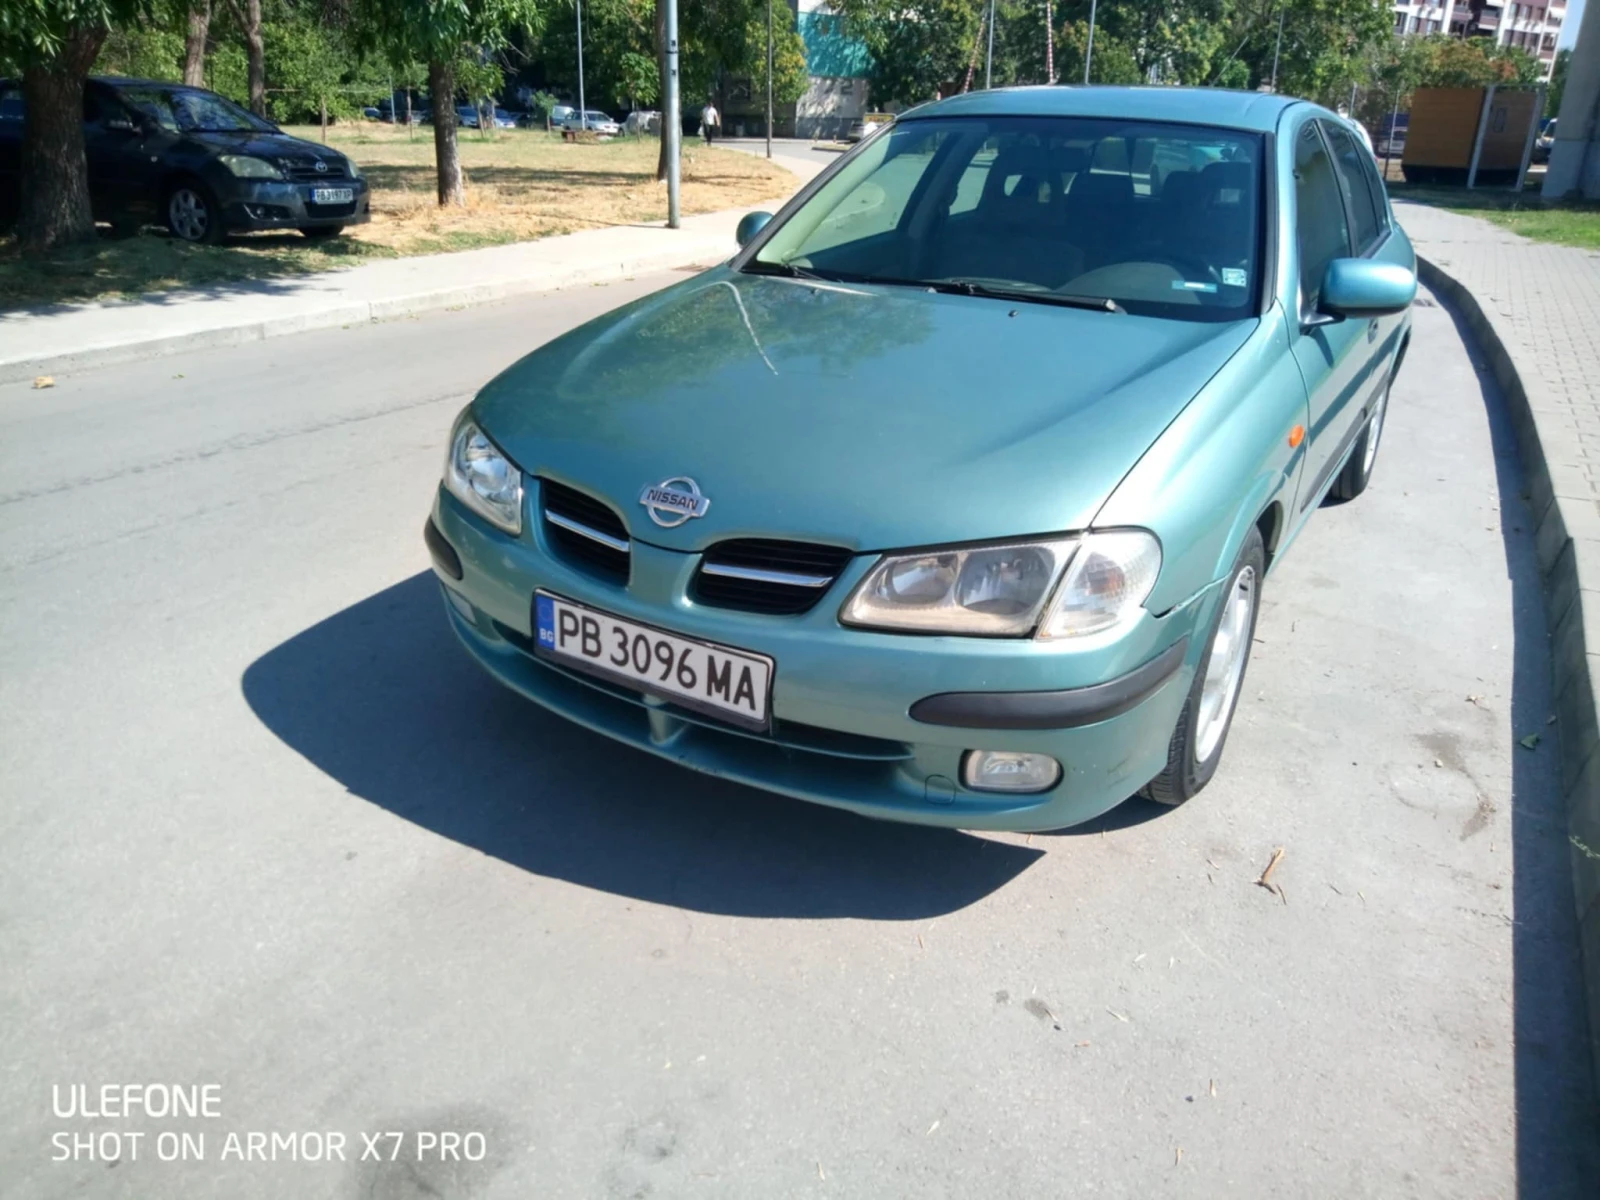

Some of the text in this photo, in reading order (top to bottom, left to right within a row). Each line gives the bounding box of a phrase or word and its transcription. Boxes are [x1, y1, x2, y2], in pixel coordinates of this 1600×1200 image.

[646, 488, 699, 511] NISSAN
[539, 627, 555, 643] BG
[558, 608, 757, 711] PB 3096 MA
